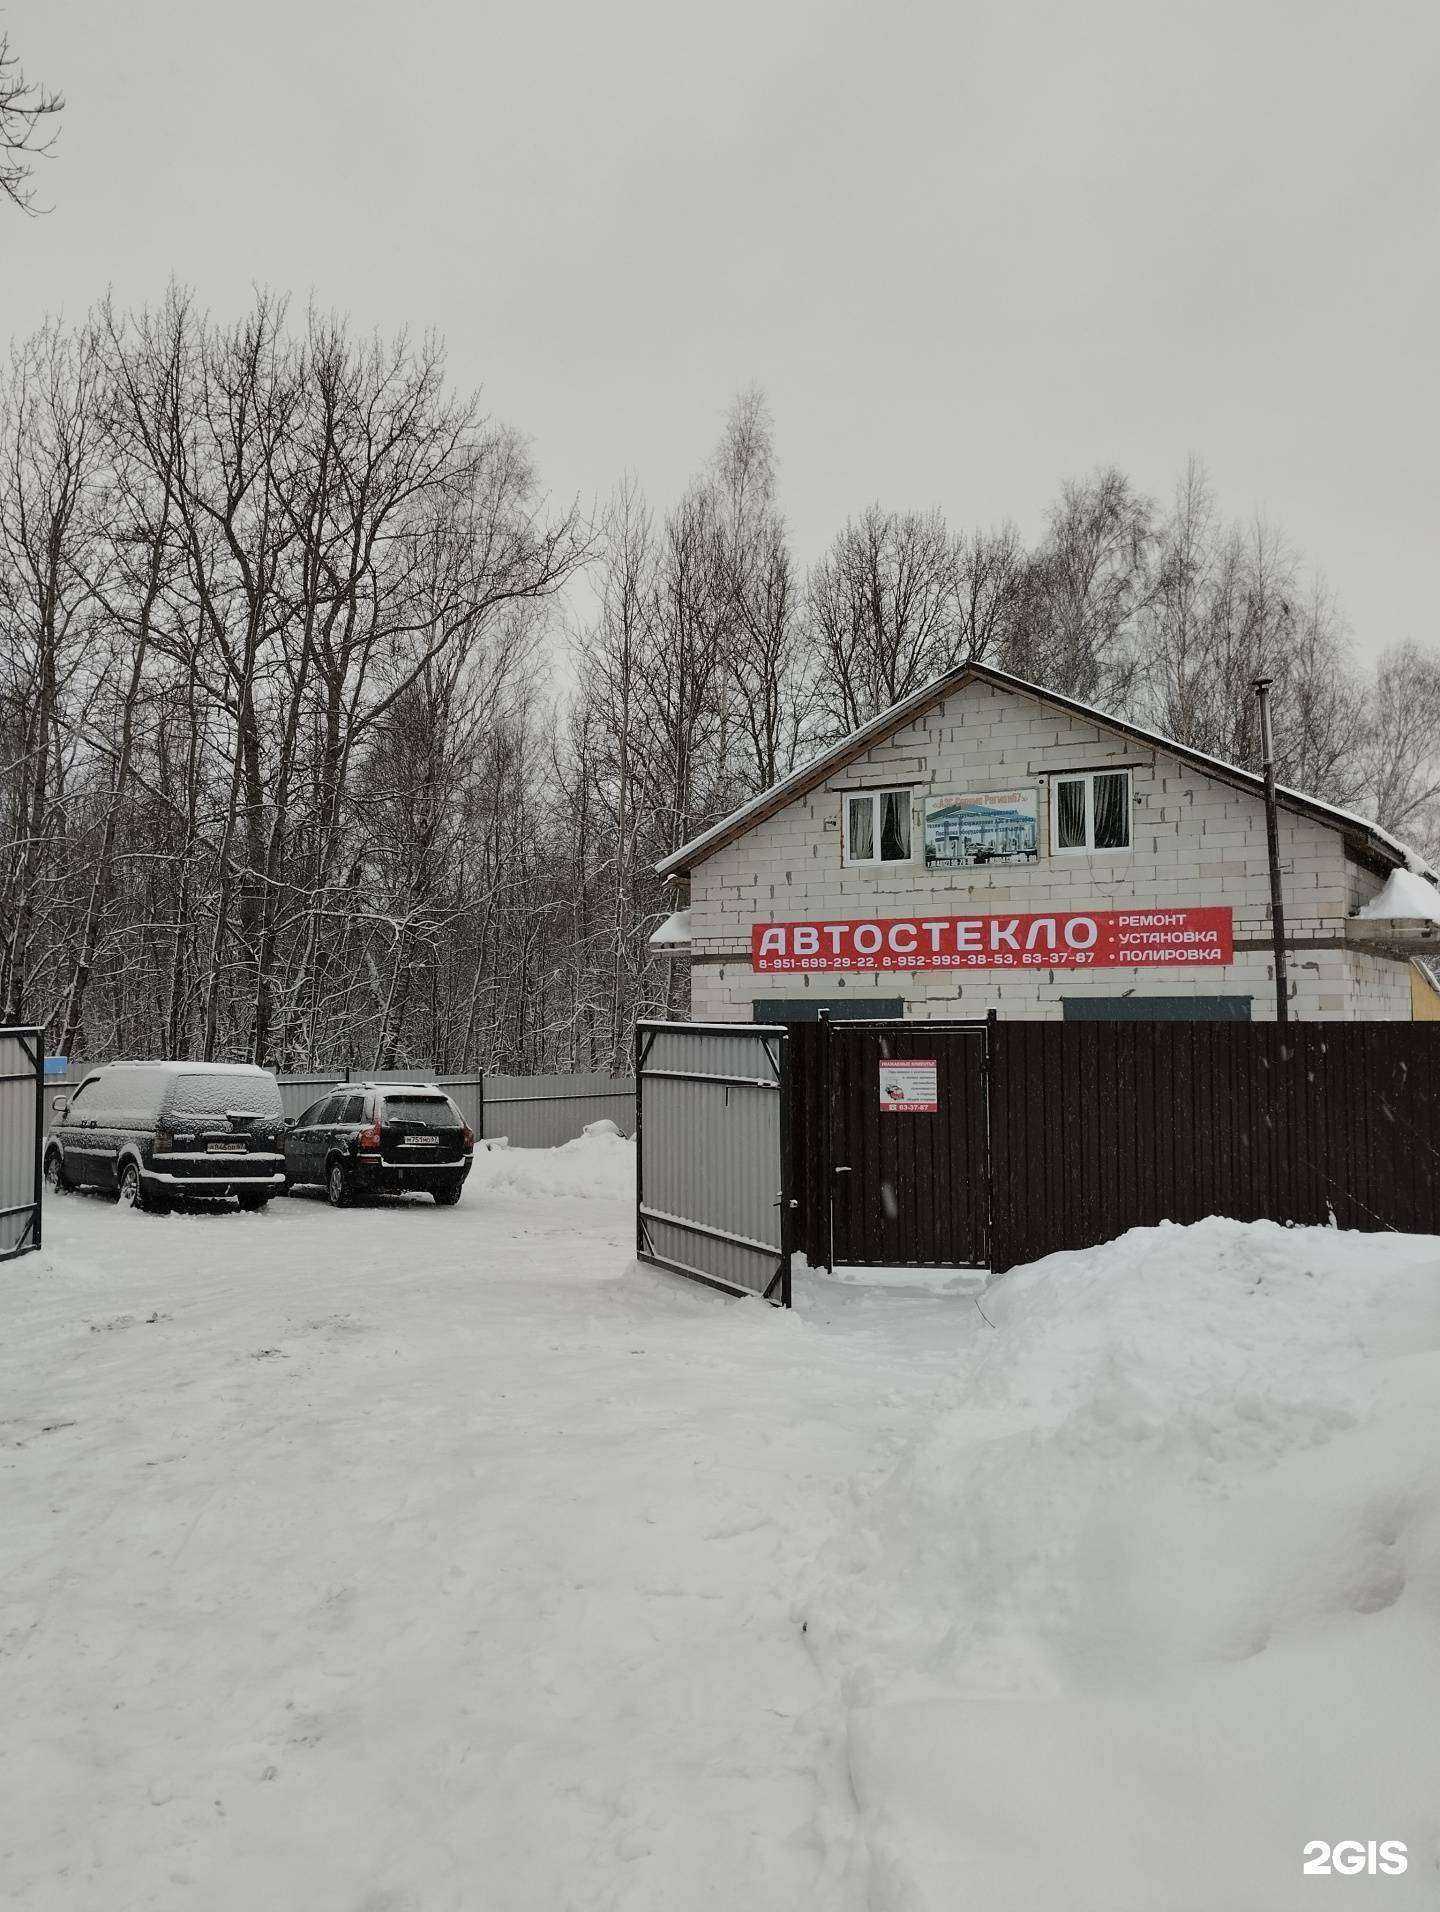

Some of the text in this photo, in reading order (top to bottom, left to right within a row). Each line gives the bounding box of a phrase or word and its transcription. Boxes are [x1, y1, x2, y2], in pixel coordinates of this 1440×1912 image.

[1119, 914, 1187, 926] РЕМОНТ
[759, 917, 1098, 956] АВТОСТЕКЛО
[1119, 931, 1218, 944] УСТАНОВКА
[759, 952, 1095, 969] 8-951-699-29-22, 8-952-993-38-53, 63-37-87
[1119, 948, 1222, 961] ПОЛИРОВКА
